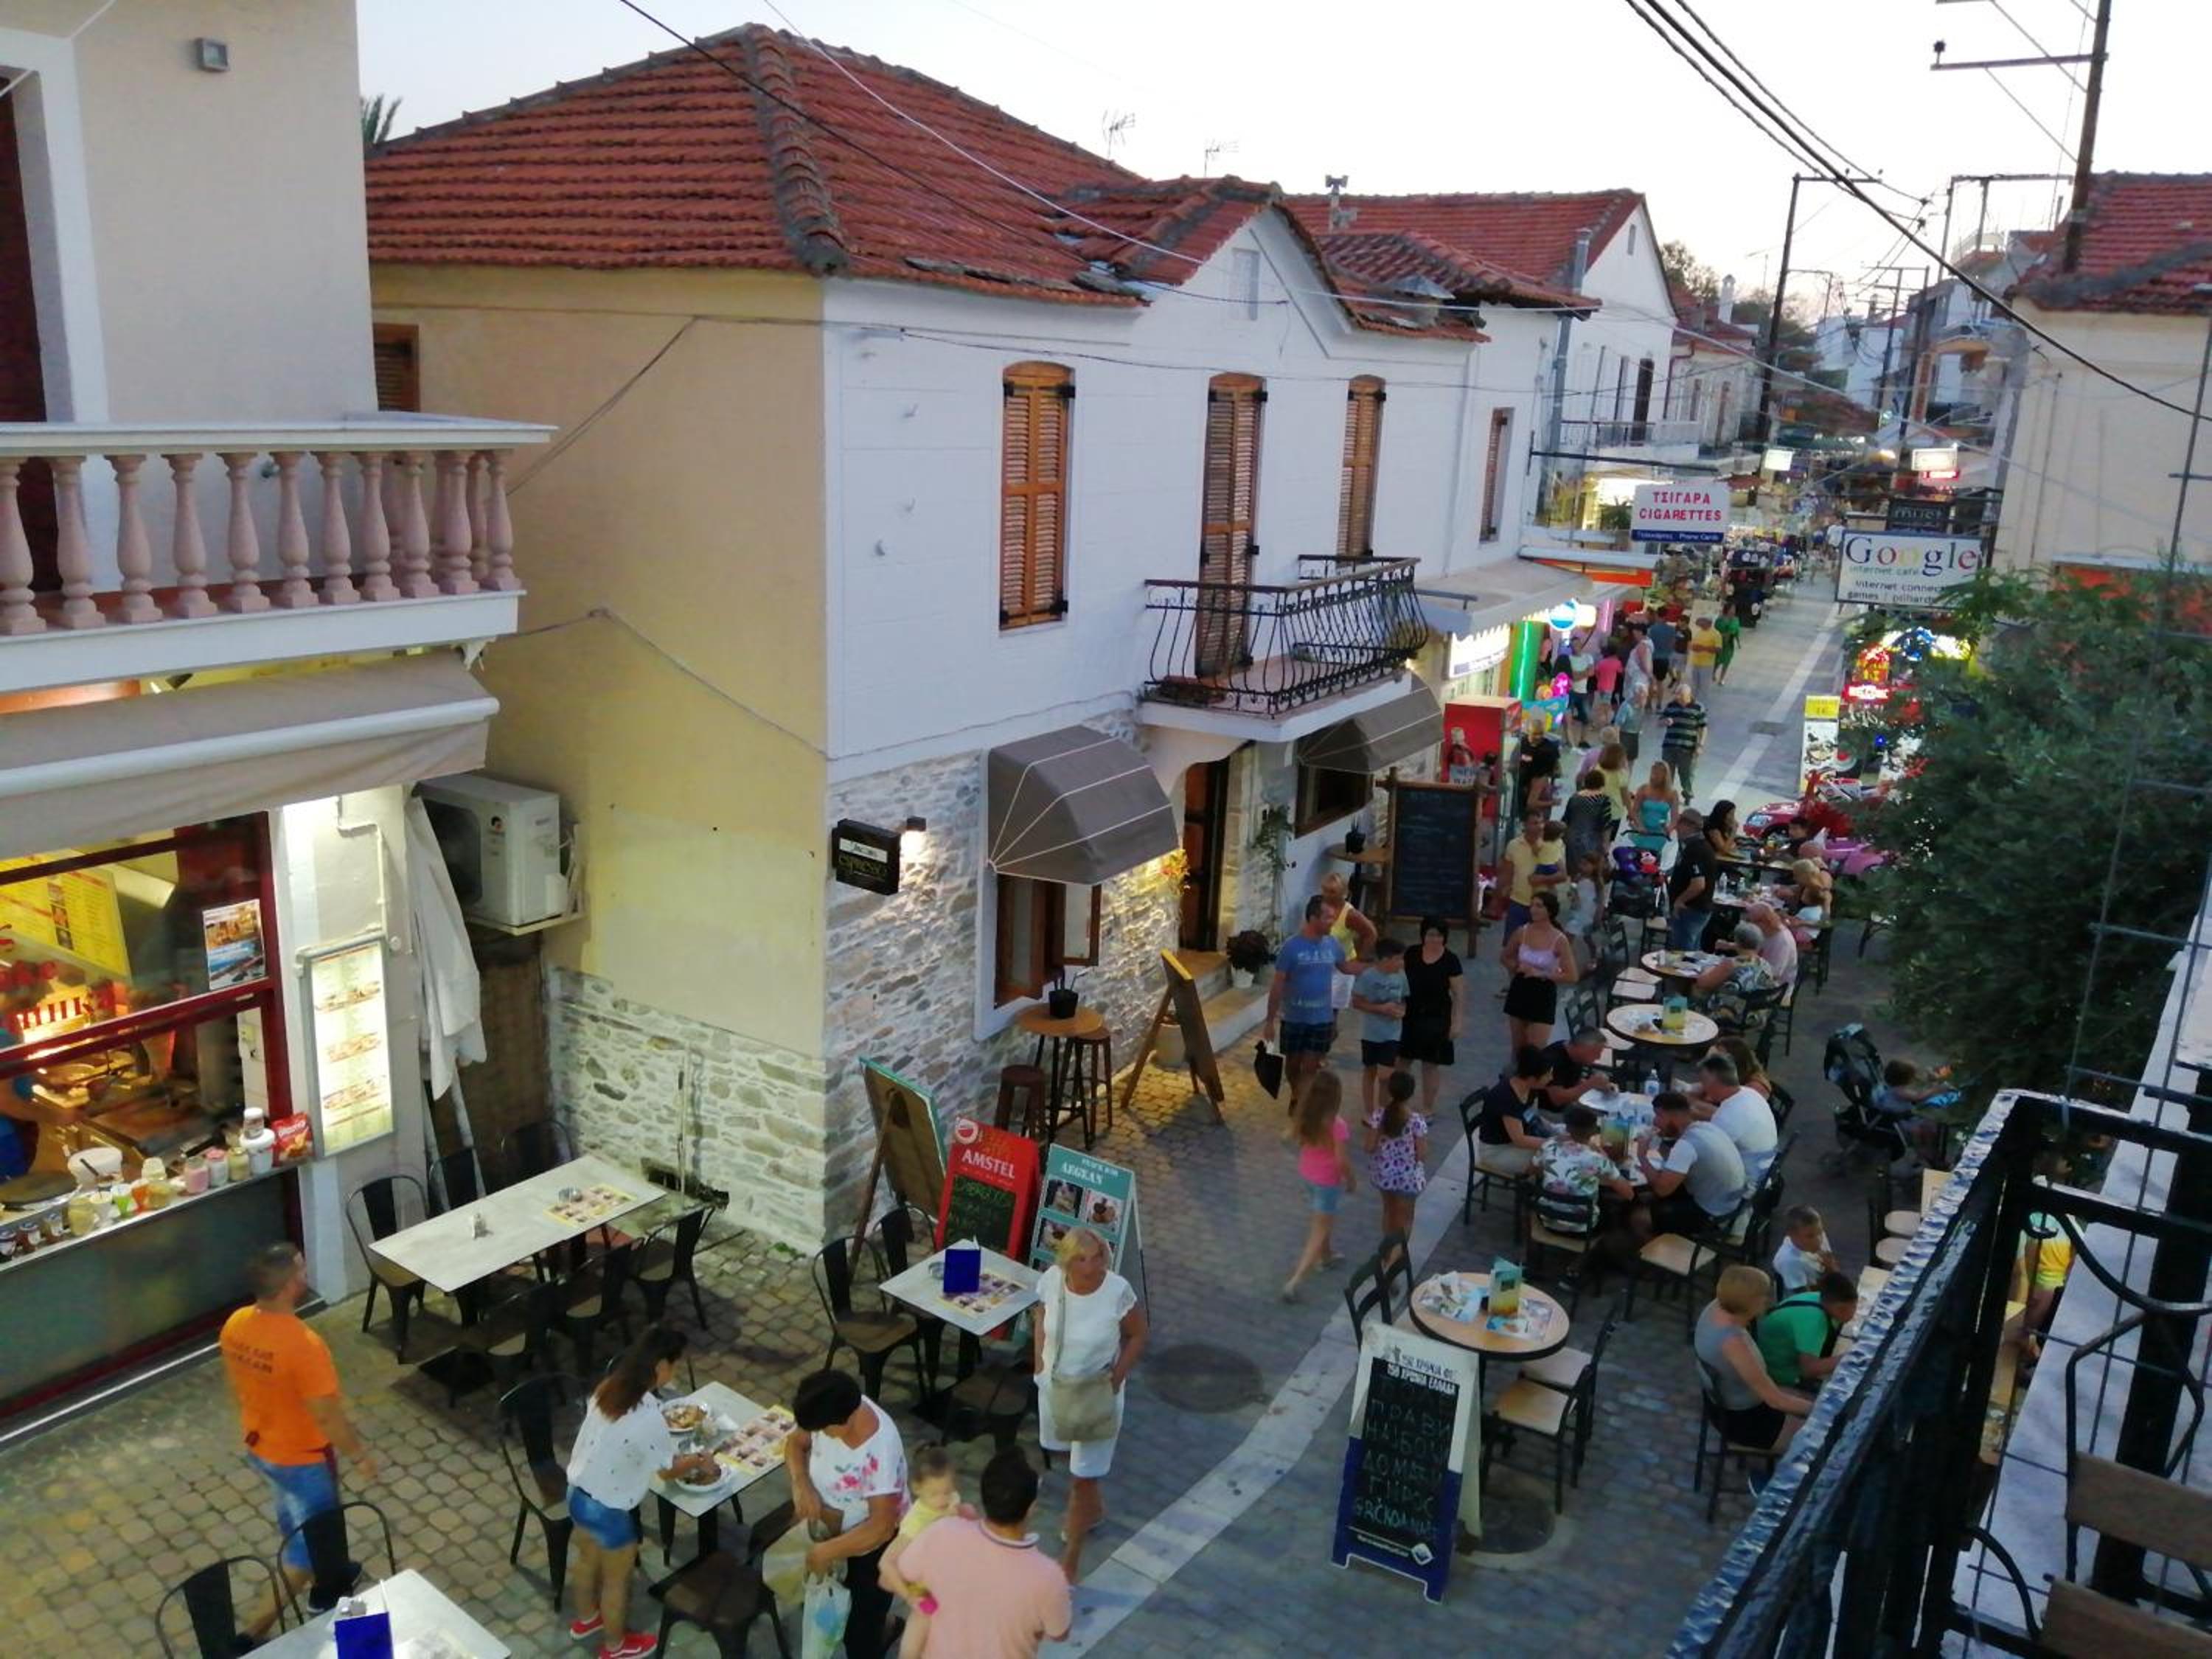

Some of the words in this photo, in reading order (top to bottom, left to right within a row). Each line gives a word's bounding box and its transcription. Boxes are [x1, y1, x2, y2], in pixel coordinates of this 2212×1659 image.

[1652, 492, 1711, 504] ΤΣΙΓΑΡΑ
[1639, 507, 1722, 521] CIGARETTES
[1846, 536, 1977, 577] Google
[961, 1149, 1015, 1179] AMSTEL
